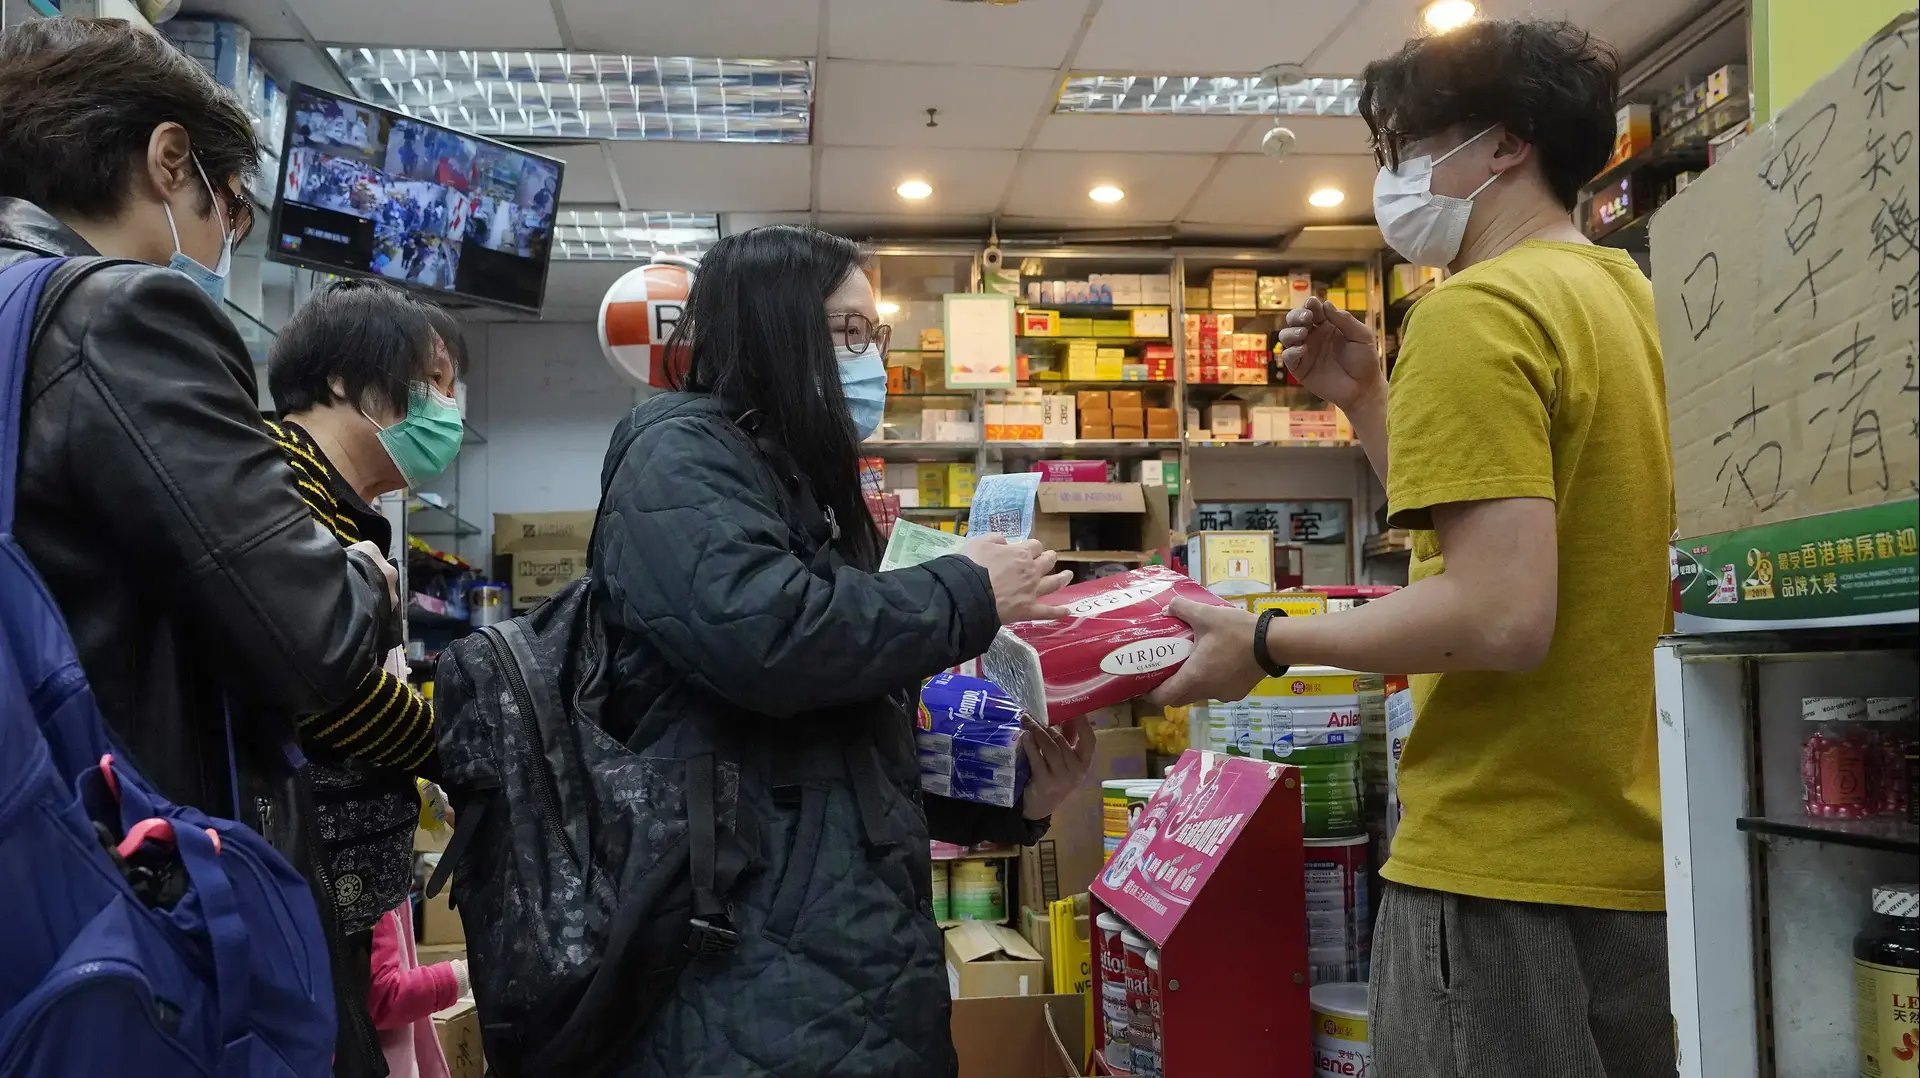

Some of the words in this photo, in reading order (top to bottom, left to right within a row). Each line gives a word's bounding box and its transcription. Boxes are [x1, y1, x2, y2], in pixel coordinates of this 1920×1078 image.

[1778, 527, 1917, 570] 最受香港藥房歡迎
[1781, 572, 1838, 598] 品牌大獎
[1115, 643, 1176, 667] VIRJOY
[1080, 962, 1091, 975] C
